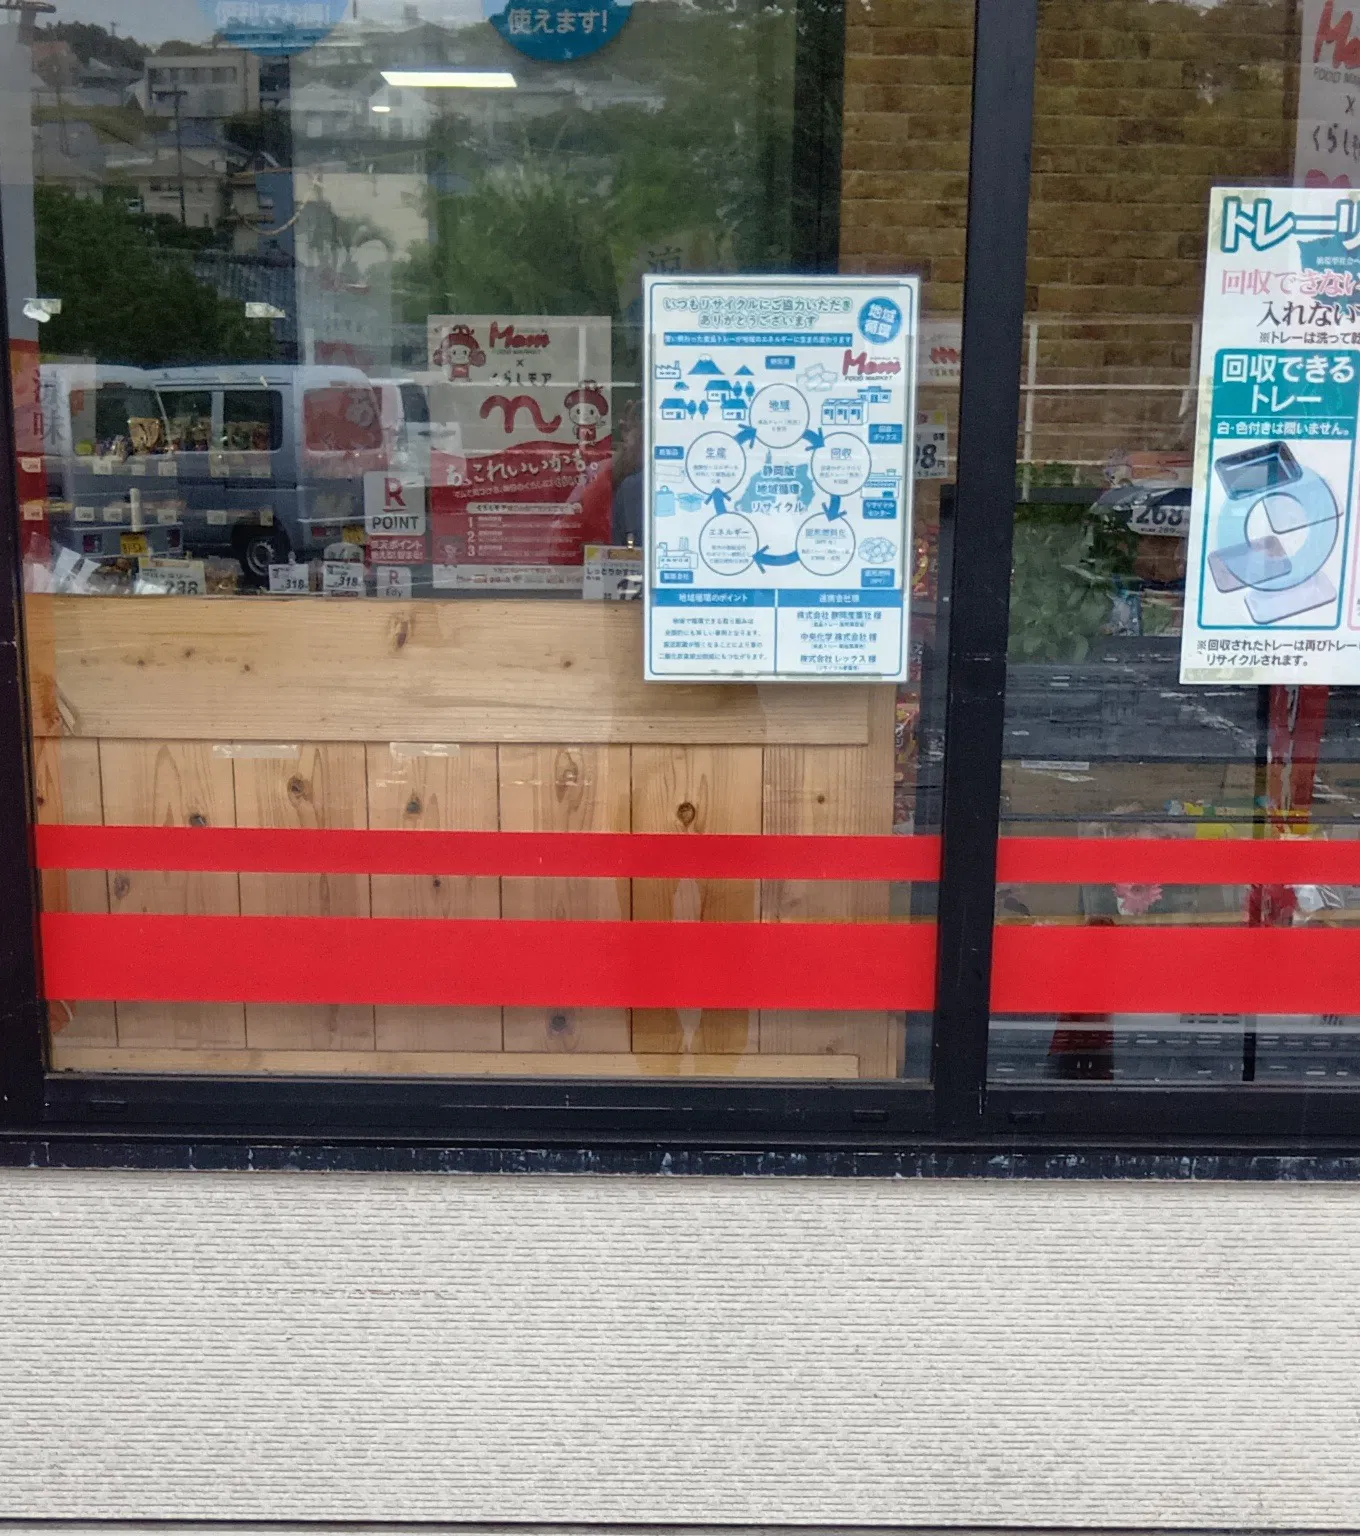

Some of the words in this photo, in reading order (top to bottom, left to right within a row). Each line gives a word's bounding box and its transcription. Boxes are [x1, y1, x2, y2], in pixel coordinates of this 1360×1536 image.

[508, 8, 607, 34] 使えます!
[663, 296, 853, 313] いつもリサイクルにご協力いただき
[698, 313, 819, 329] ありがとうございます
[1221, 354, 1354, 384] 回収できる
[1249, 385, 1324, 415] トレー
[751, 501, 806, 514] リサイクル
[372, 515, 420, 531] POINT
[709, 527, 751, 538] エネルギー
[1205, 654, 1309, 668] リサイクルされます。
